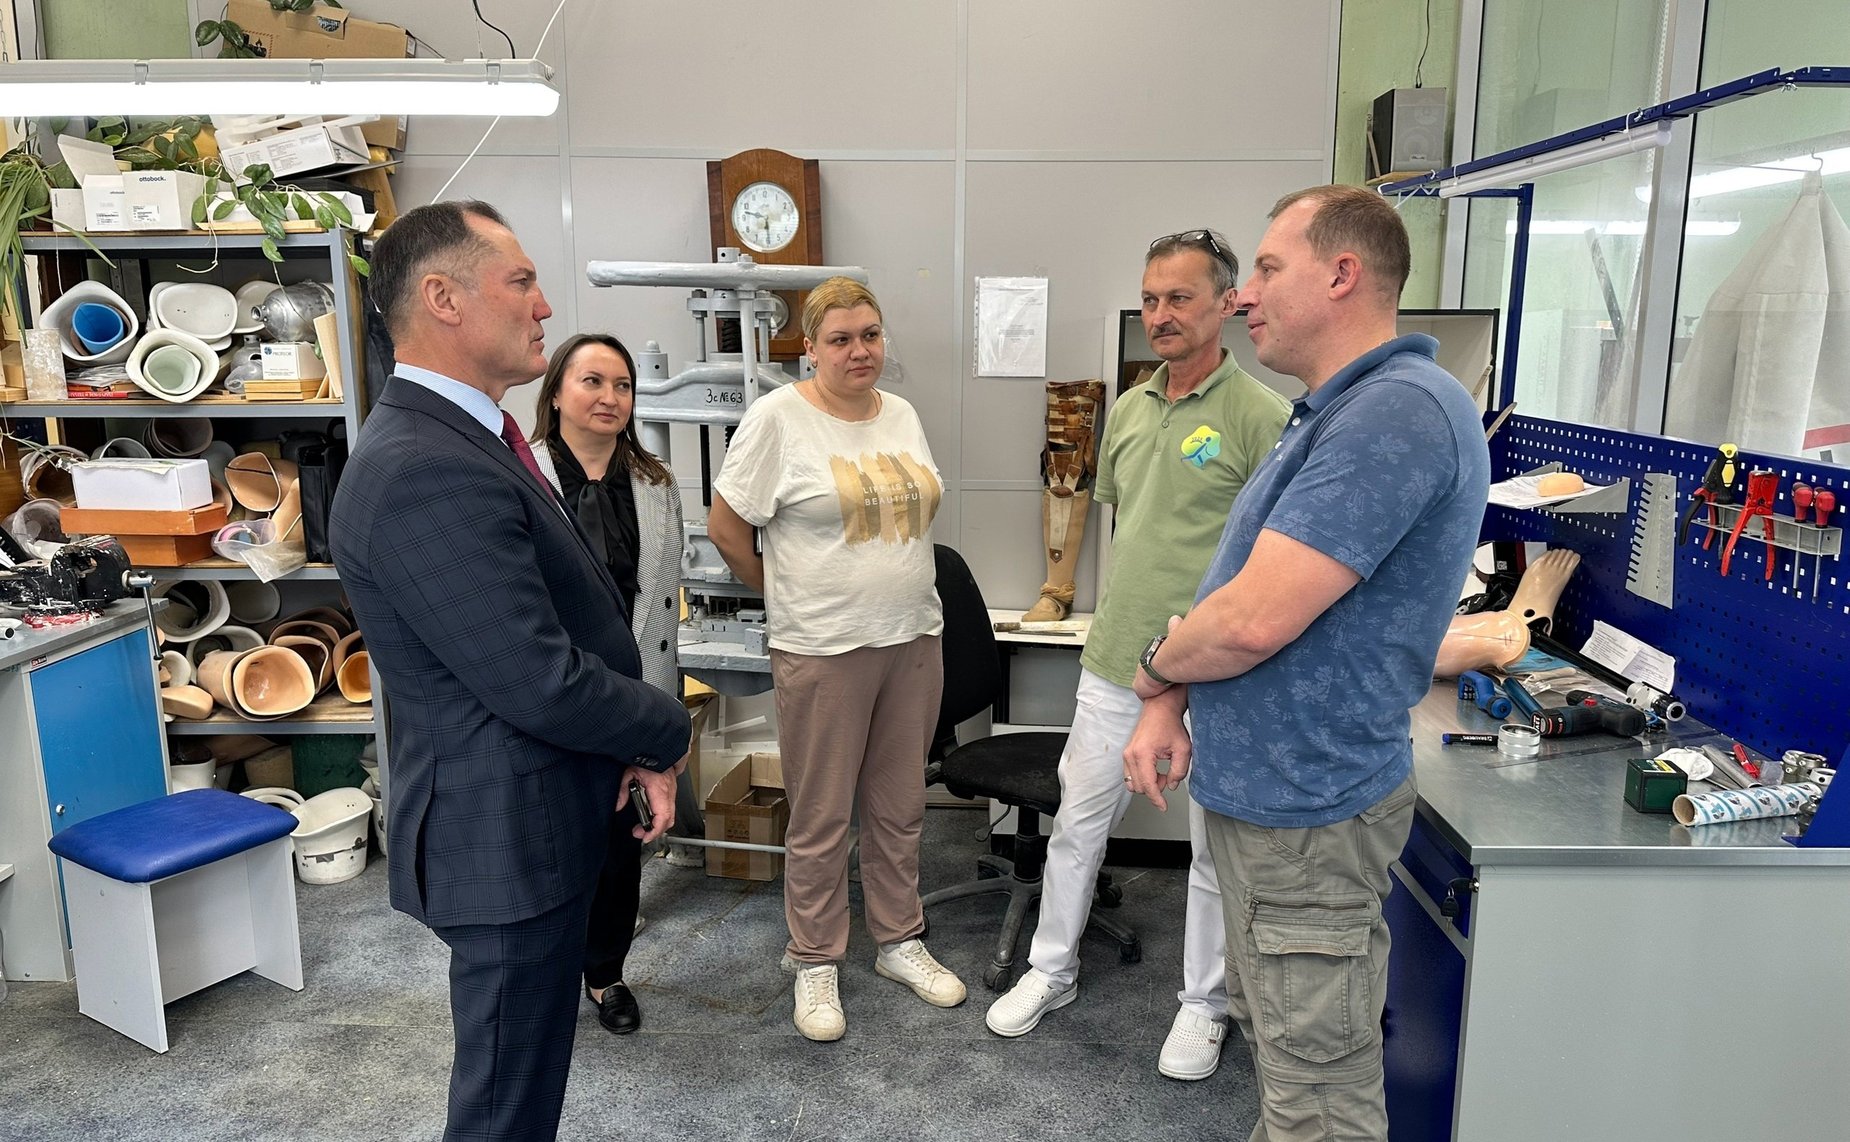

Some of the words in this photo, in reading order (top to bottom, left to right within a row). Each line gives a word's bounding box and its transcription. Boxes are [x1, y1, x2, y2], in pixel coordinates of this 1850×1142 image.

[863, 484, 886, 494] LIFE
[891, 483, 902, 492] IS
[906, 480, 921, 490] SO
[864, 492, 924, 506] BEAUTIFUL
